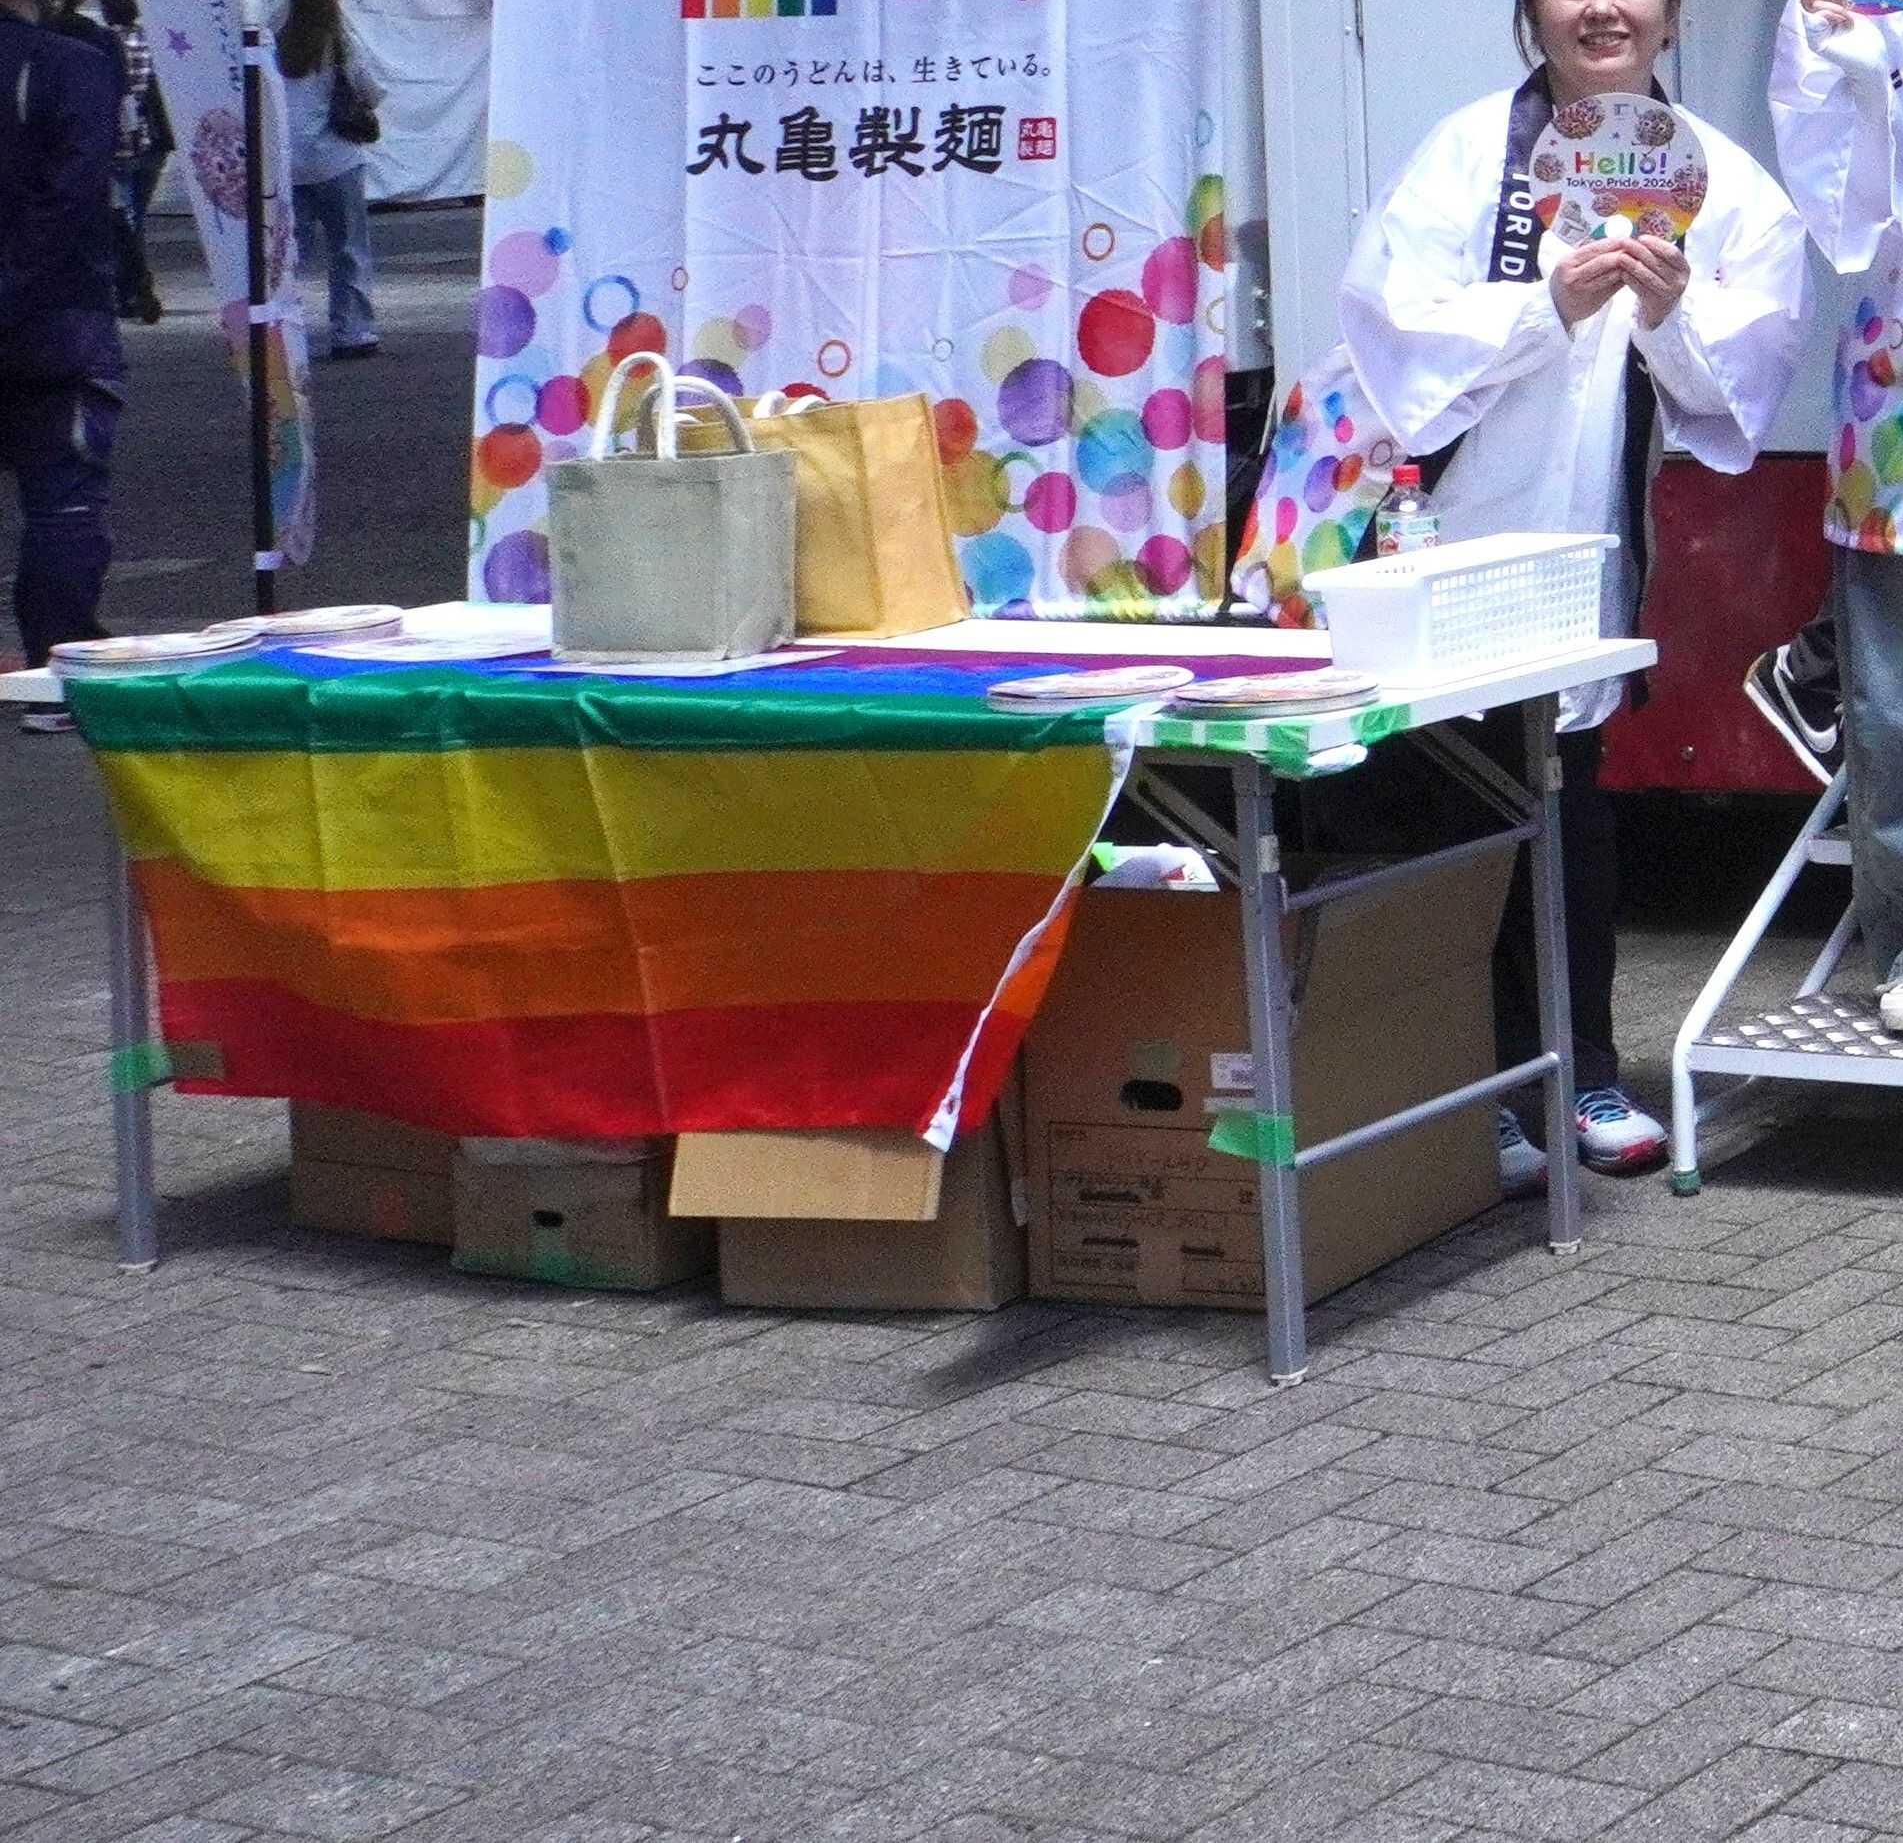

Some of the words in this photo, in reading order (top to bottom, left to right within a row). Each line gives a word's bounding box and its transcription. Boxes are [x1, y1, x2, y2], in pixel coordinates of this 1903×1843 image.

[697, 53, 1051, 88] ここのうどんは、生きている。
[685, 103, 1007, 182] 丸亀製麺
[1574, 151, 1667, 175] Hello!
[1566, 177, 1603, 189] Tokyo
[1607, 177, 1639, 188] Pride
[1643, 177, 1674, 188] 2026
